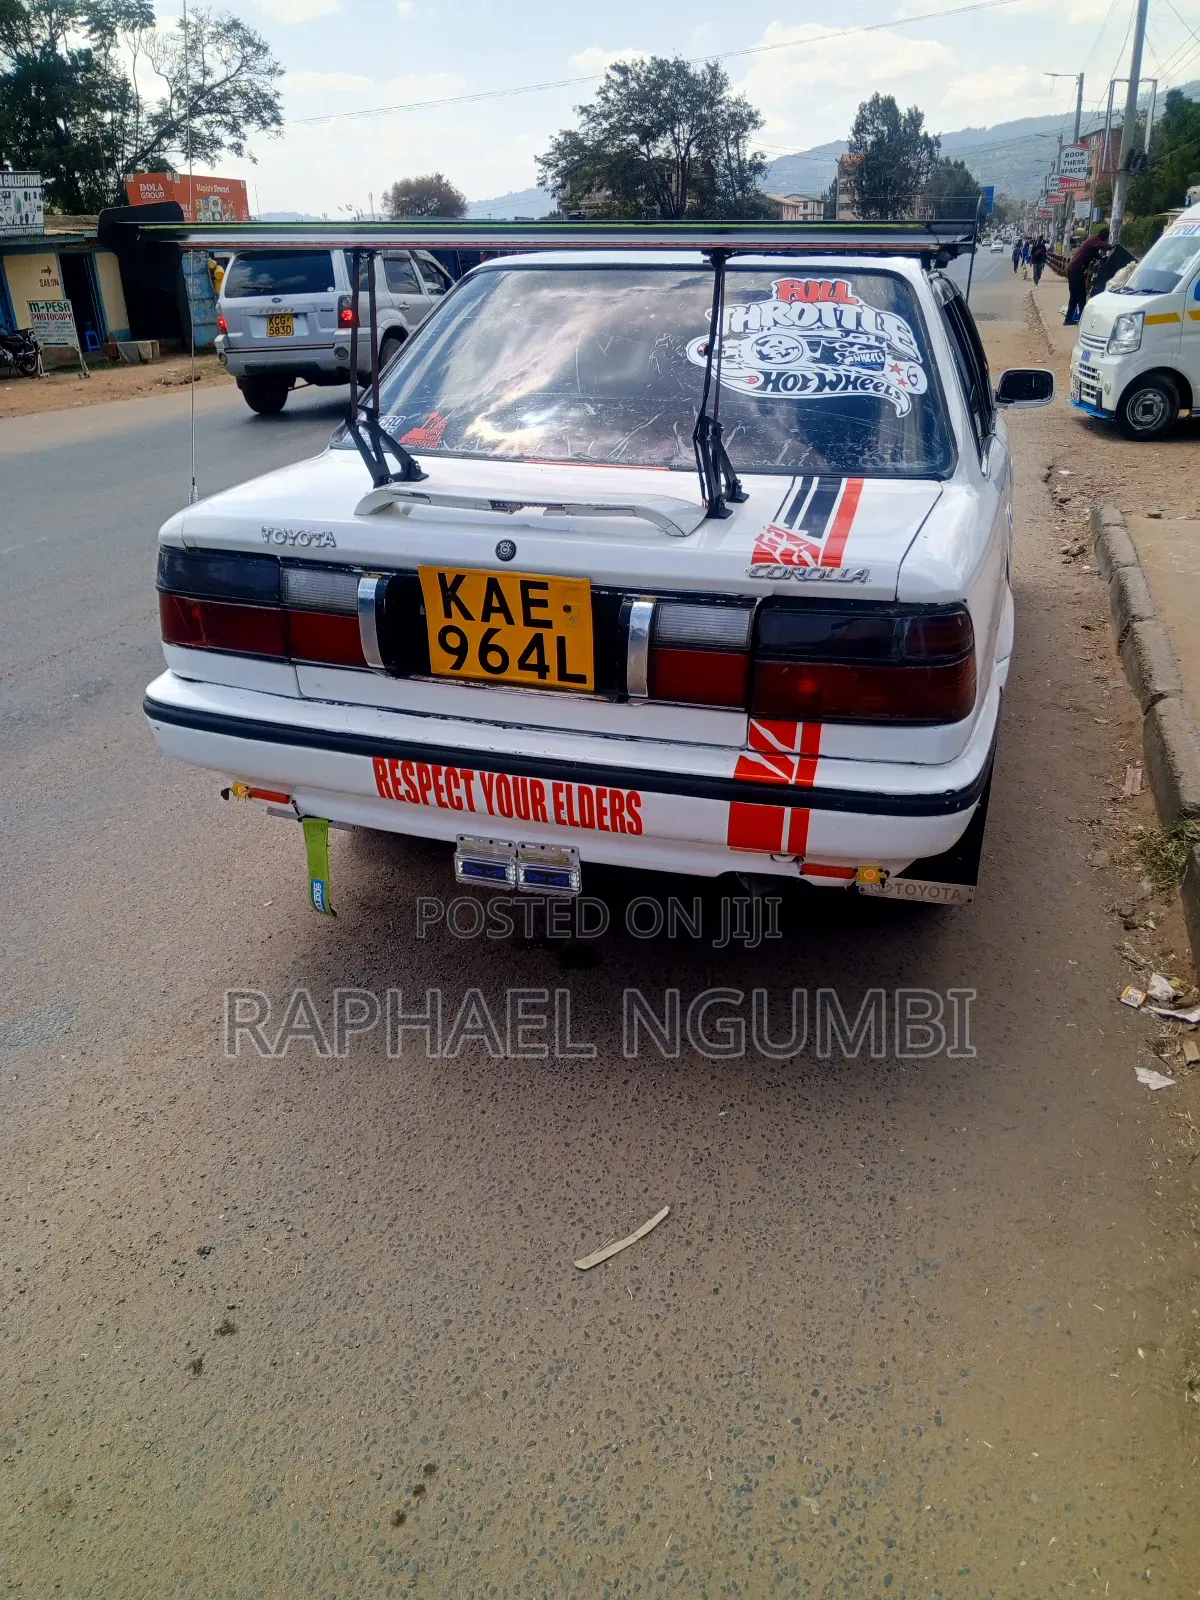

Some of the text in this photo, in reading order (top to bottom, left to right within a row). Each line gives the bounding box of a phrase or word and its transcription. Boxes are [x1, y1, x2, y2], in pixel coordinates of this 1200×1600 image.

[1061, 167, 1087, 175] SPACES
[4, 174, 41, 187] COLLECTIONS
[140, 183, 164, 192] DOLA
[39, 278, 60, 288] SALON
[777, 279, 859, 304] FULL
[29, 301, 71, 313] M-PESA
[32, 313, 73, 321] PHOTOCOPY
[268, 315, 286, 326] KCG
[268, 326, 292, 335] 583D
[706, 301, 922, 363] THROTTLE
[261, 526, 337, 548] TOYOTA
[749, 564, 871, 583] COROLLA
[437, 572, 553, 629] KAE
[437, 624, 588, 684] 964L
[372, 756, 644, 836] RESPECT YOUR ELDERS
[895, 882, 962, 901] TOYOTA
